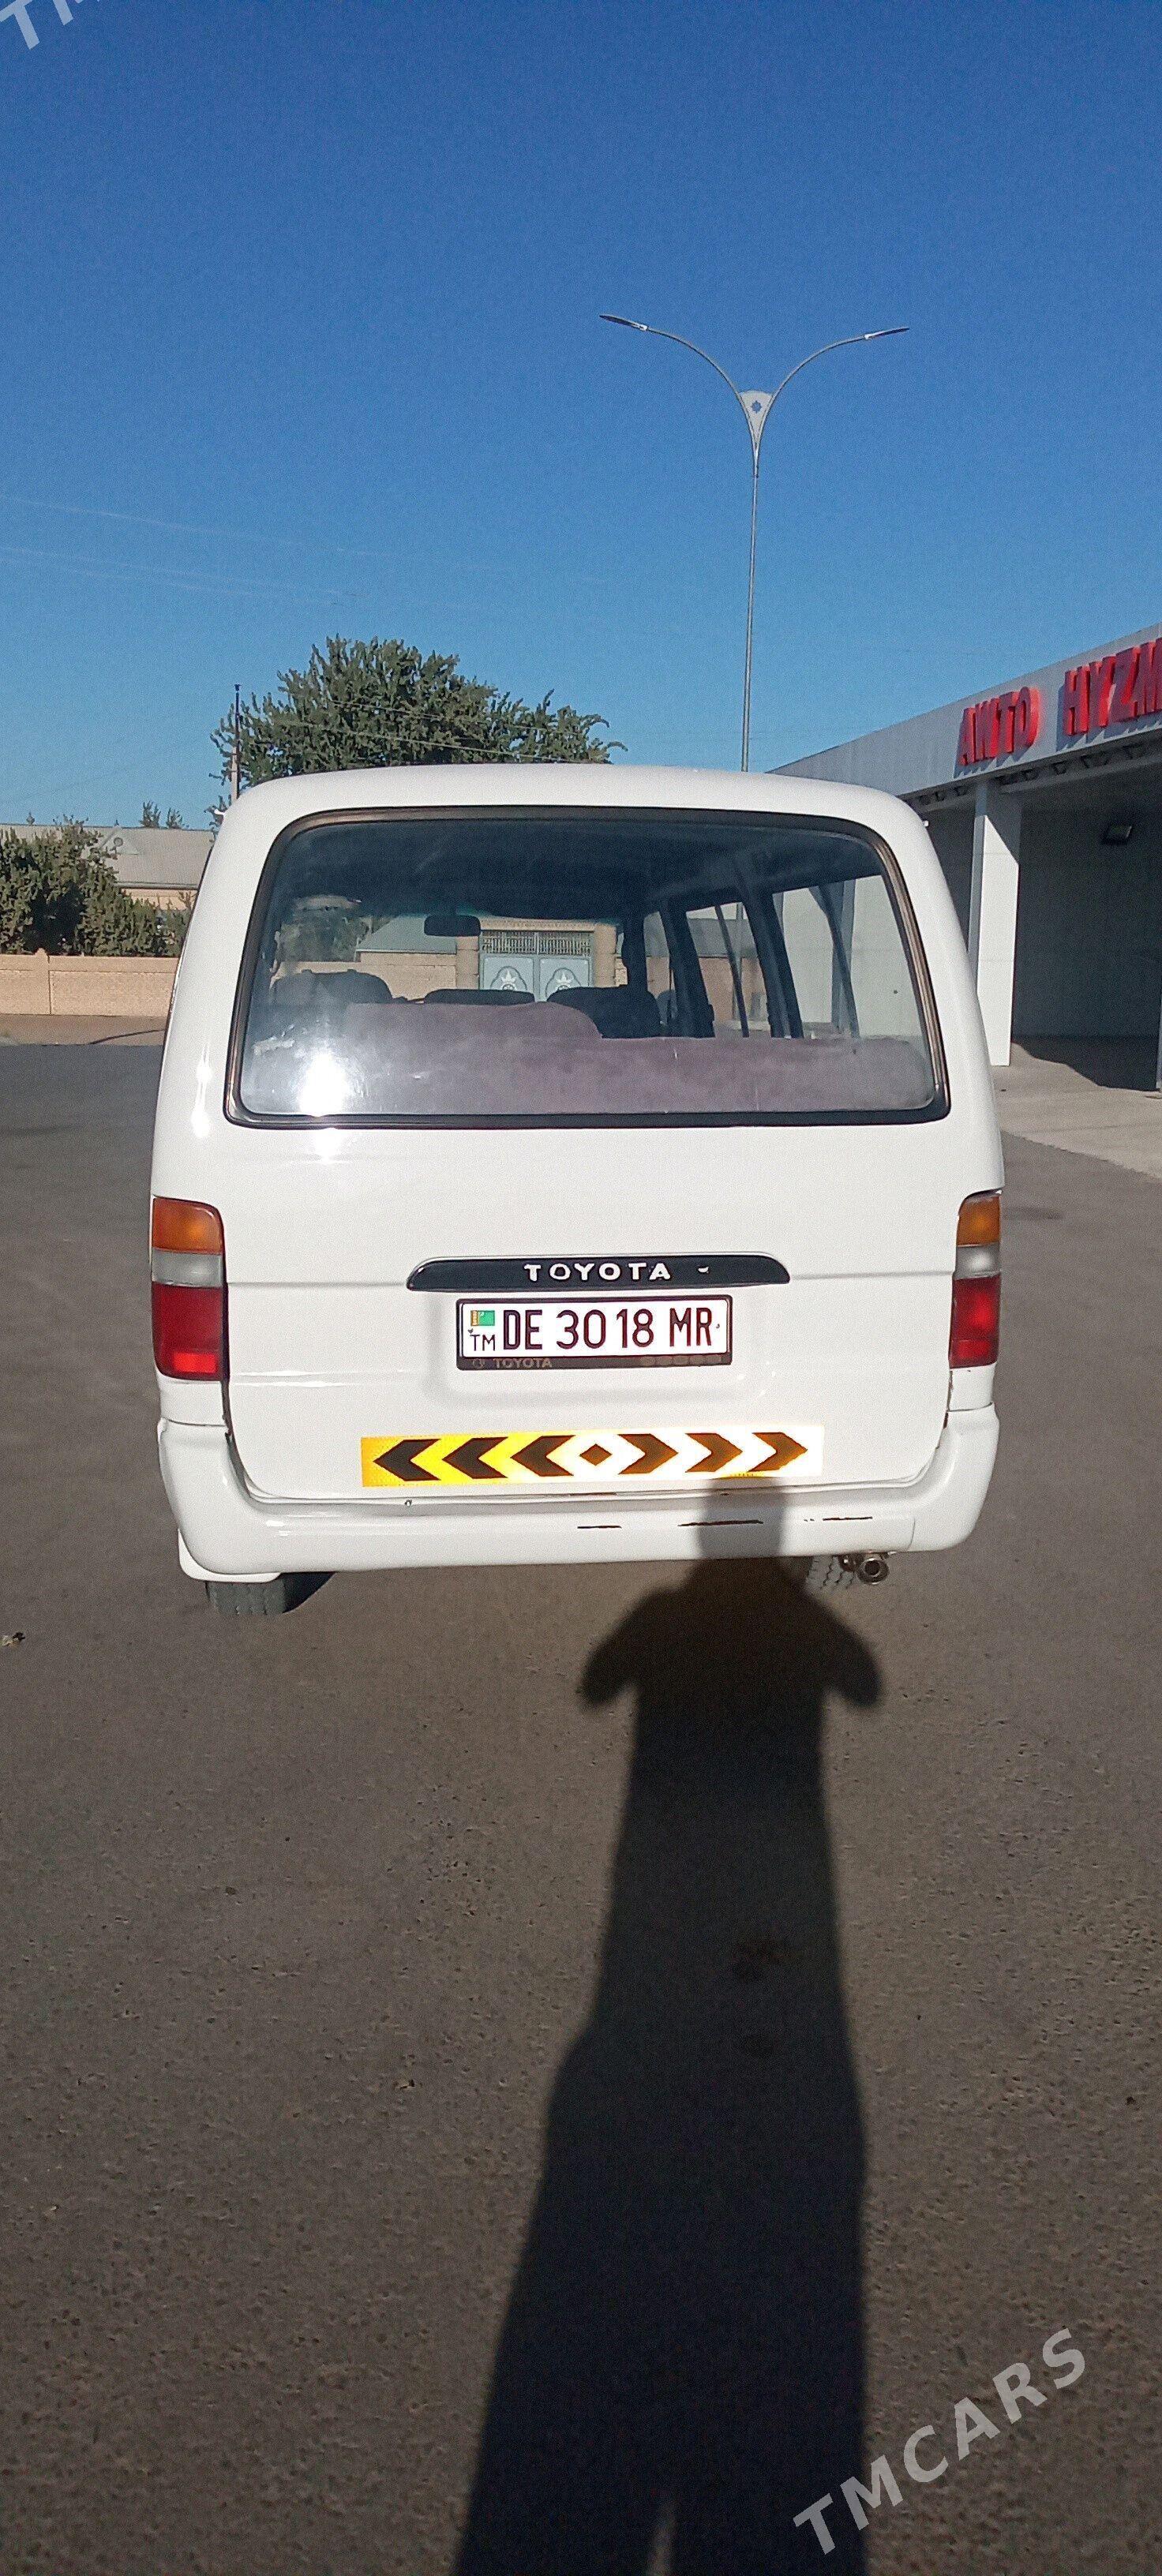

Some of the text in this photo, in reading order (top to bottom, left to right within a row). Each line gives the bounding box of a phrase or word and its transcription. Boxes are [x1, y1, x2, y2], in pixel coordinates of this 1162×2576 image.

[958, 686, 1041, 766] AWTO
[524, 1263, 671, 1281] TOYOTA
[503, 1307, 712, 1350] DE 3018 MR
[470, 1334, 496, 1351] TM
[493, 1357, 553, 1368] TOYOTA
